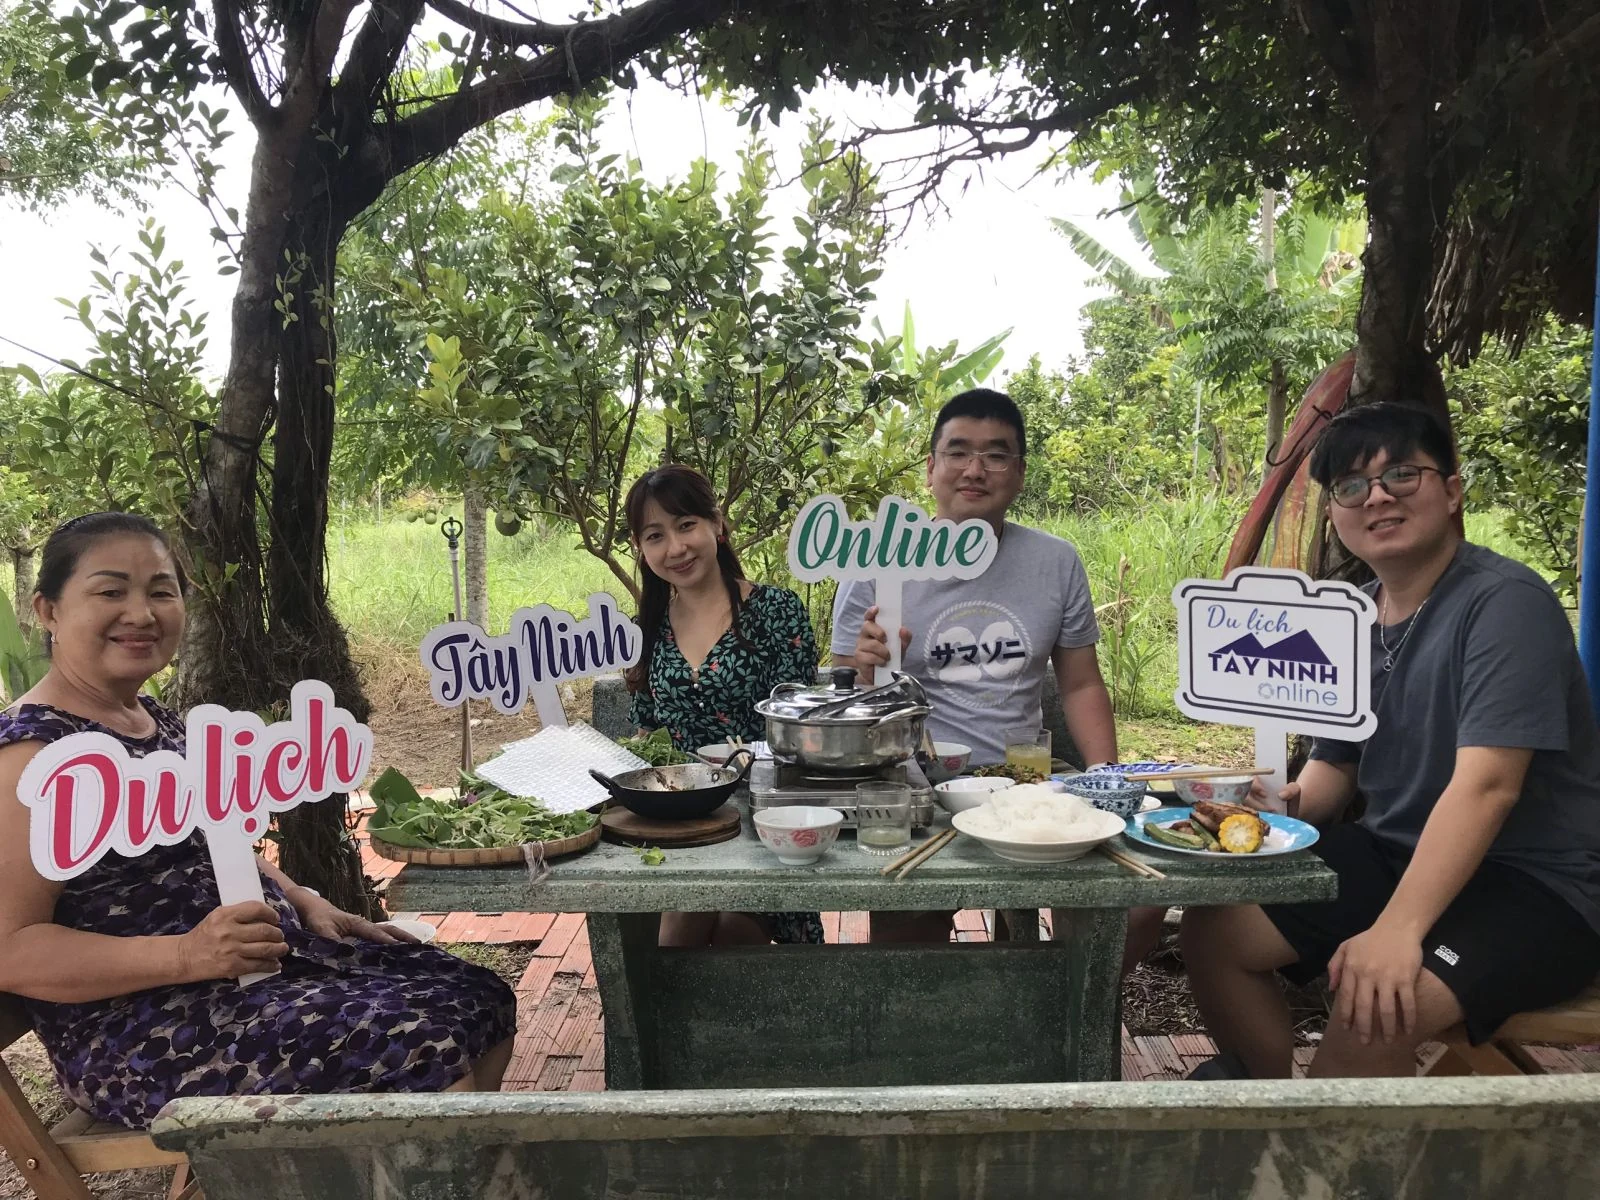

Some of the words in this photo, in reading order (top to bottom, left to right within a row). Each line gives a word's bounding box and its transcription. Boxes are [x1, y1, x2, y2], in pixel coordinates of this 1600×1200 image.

[797, 501, 989, 570] Online
[1207, 603, 1241, 630] Du
[1246, 607, 1293, 635] lịch
[431, 633, 521, 709] Tây
[521, 604, 634, 682] Ninh
[930, 640, 1026, 670] サマソニ
[1267, 659, 1338, 686] NINH
[40, 753, 192, 871] Du
[205, 698, 362, 833] lịch
[1439, 945, 1460, 961] COOL
